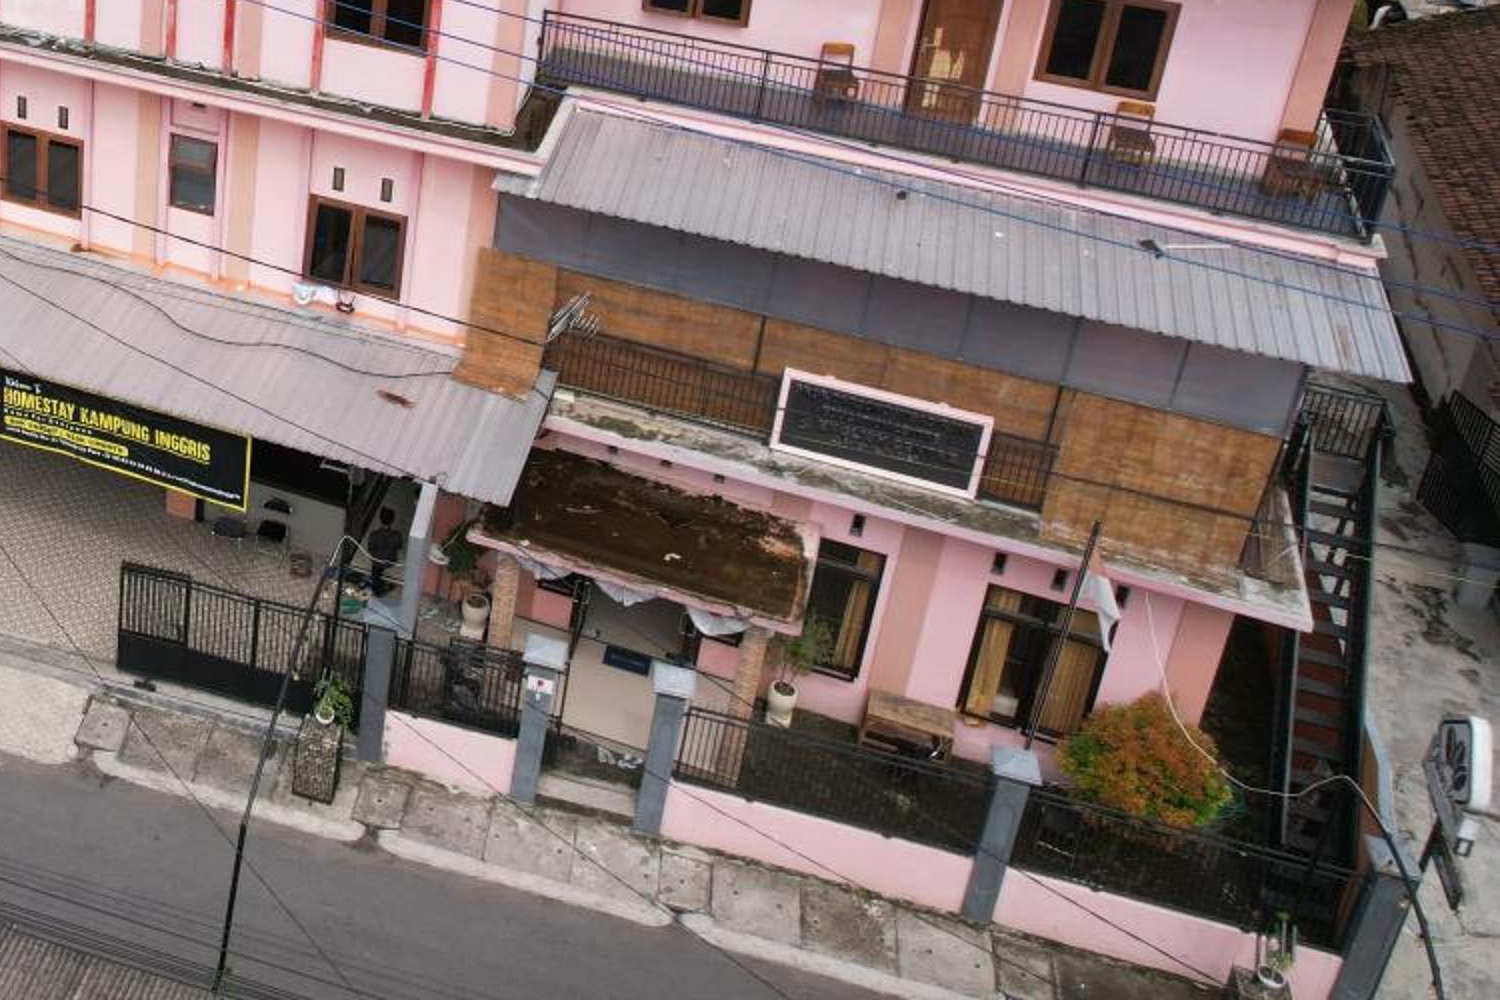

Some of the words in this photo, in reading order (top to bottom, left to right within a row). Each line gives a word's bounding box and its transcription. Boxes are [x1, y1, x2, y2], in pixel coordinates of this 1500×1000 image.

[4, 387, 75, 421] HOMESTAY
[79, 406, 150, 441] KAMPUNG
[155, 430, 211, 461] INGGRIS
